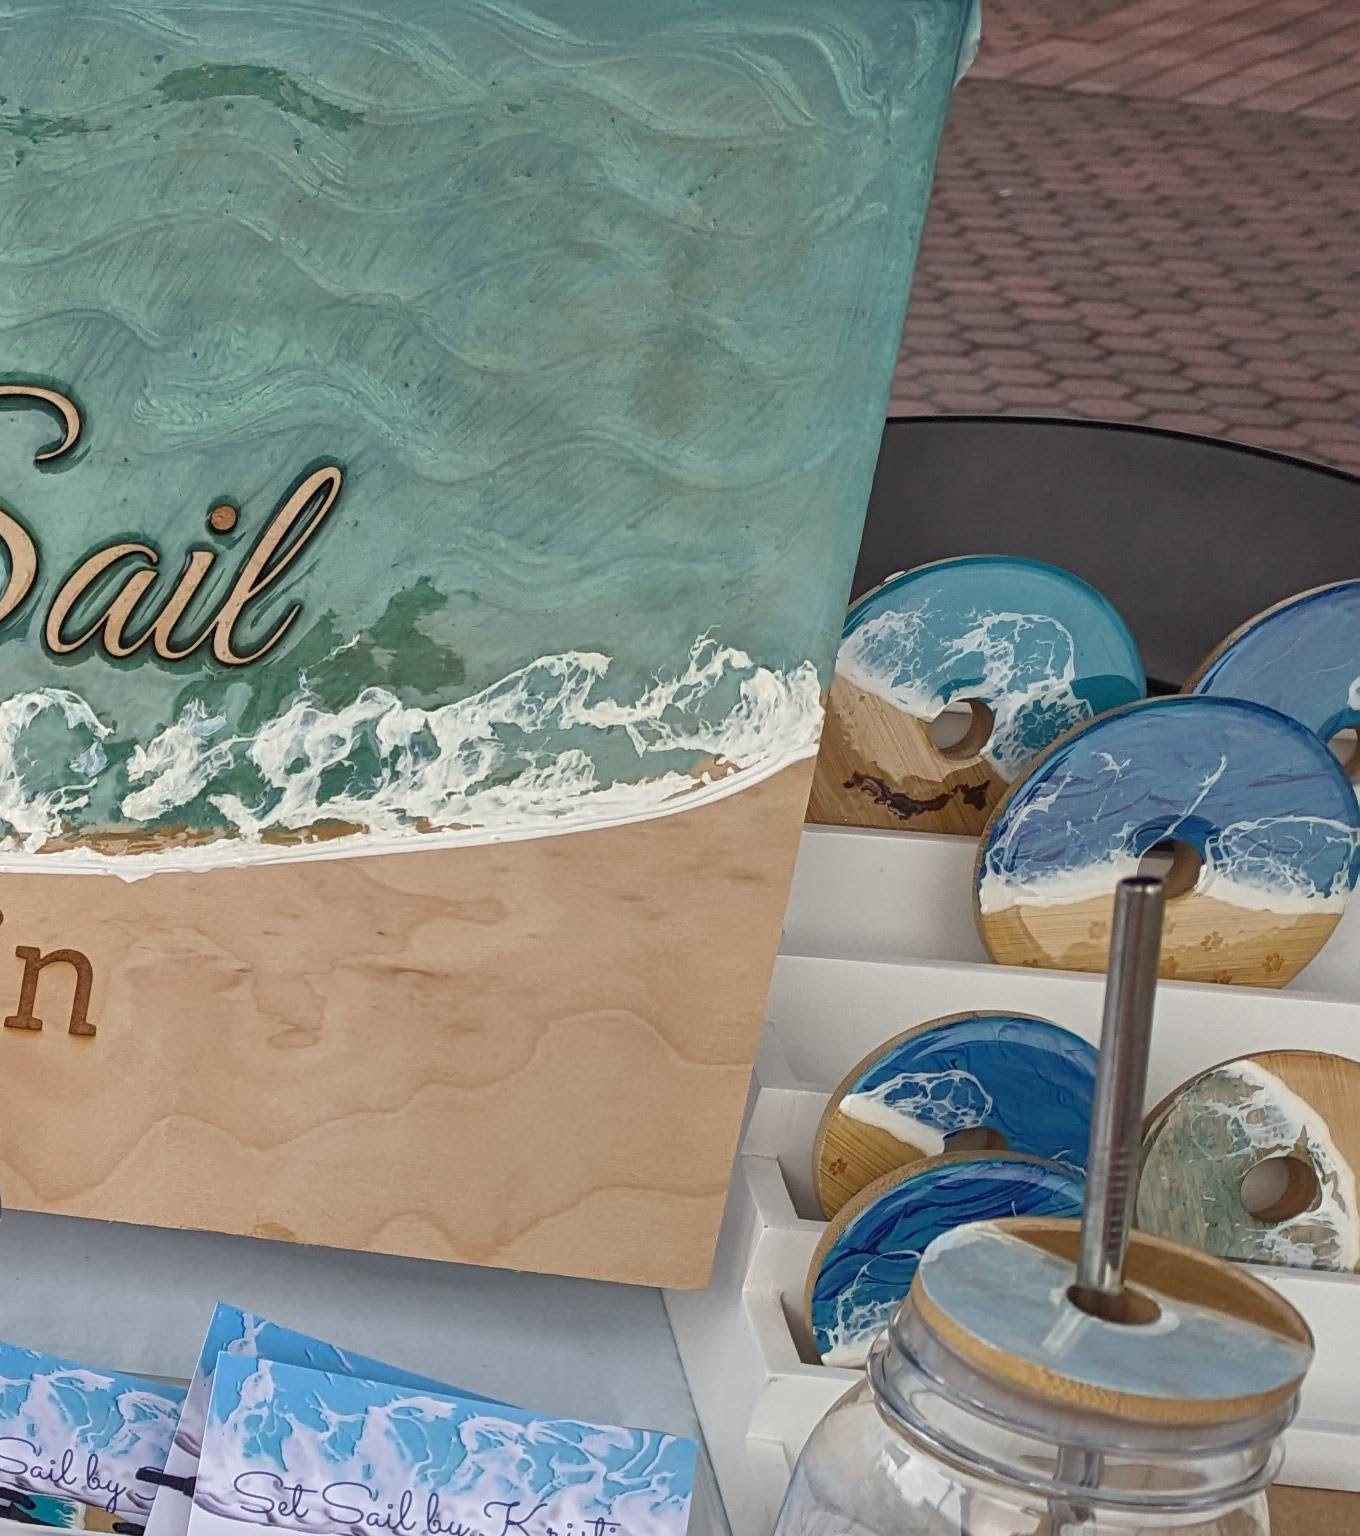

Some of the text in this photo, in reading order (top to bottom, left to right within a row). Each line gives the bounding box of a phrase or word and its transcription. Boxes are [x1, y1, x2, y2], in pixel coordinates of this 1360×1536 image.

[87, 1454, 128, 1511] by
[234, 1471, 317, 1520] Set
[322, 1482, 416, 1532] Sail
